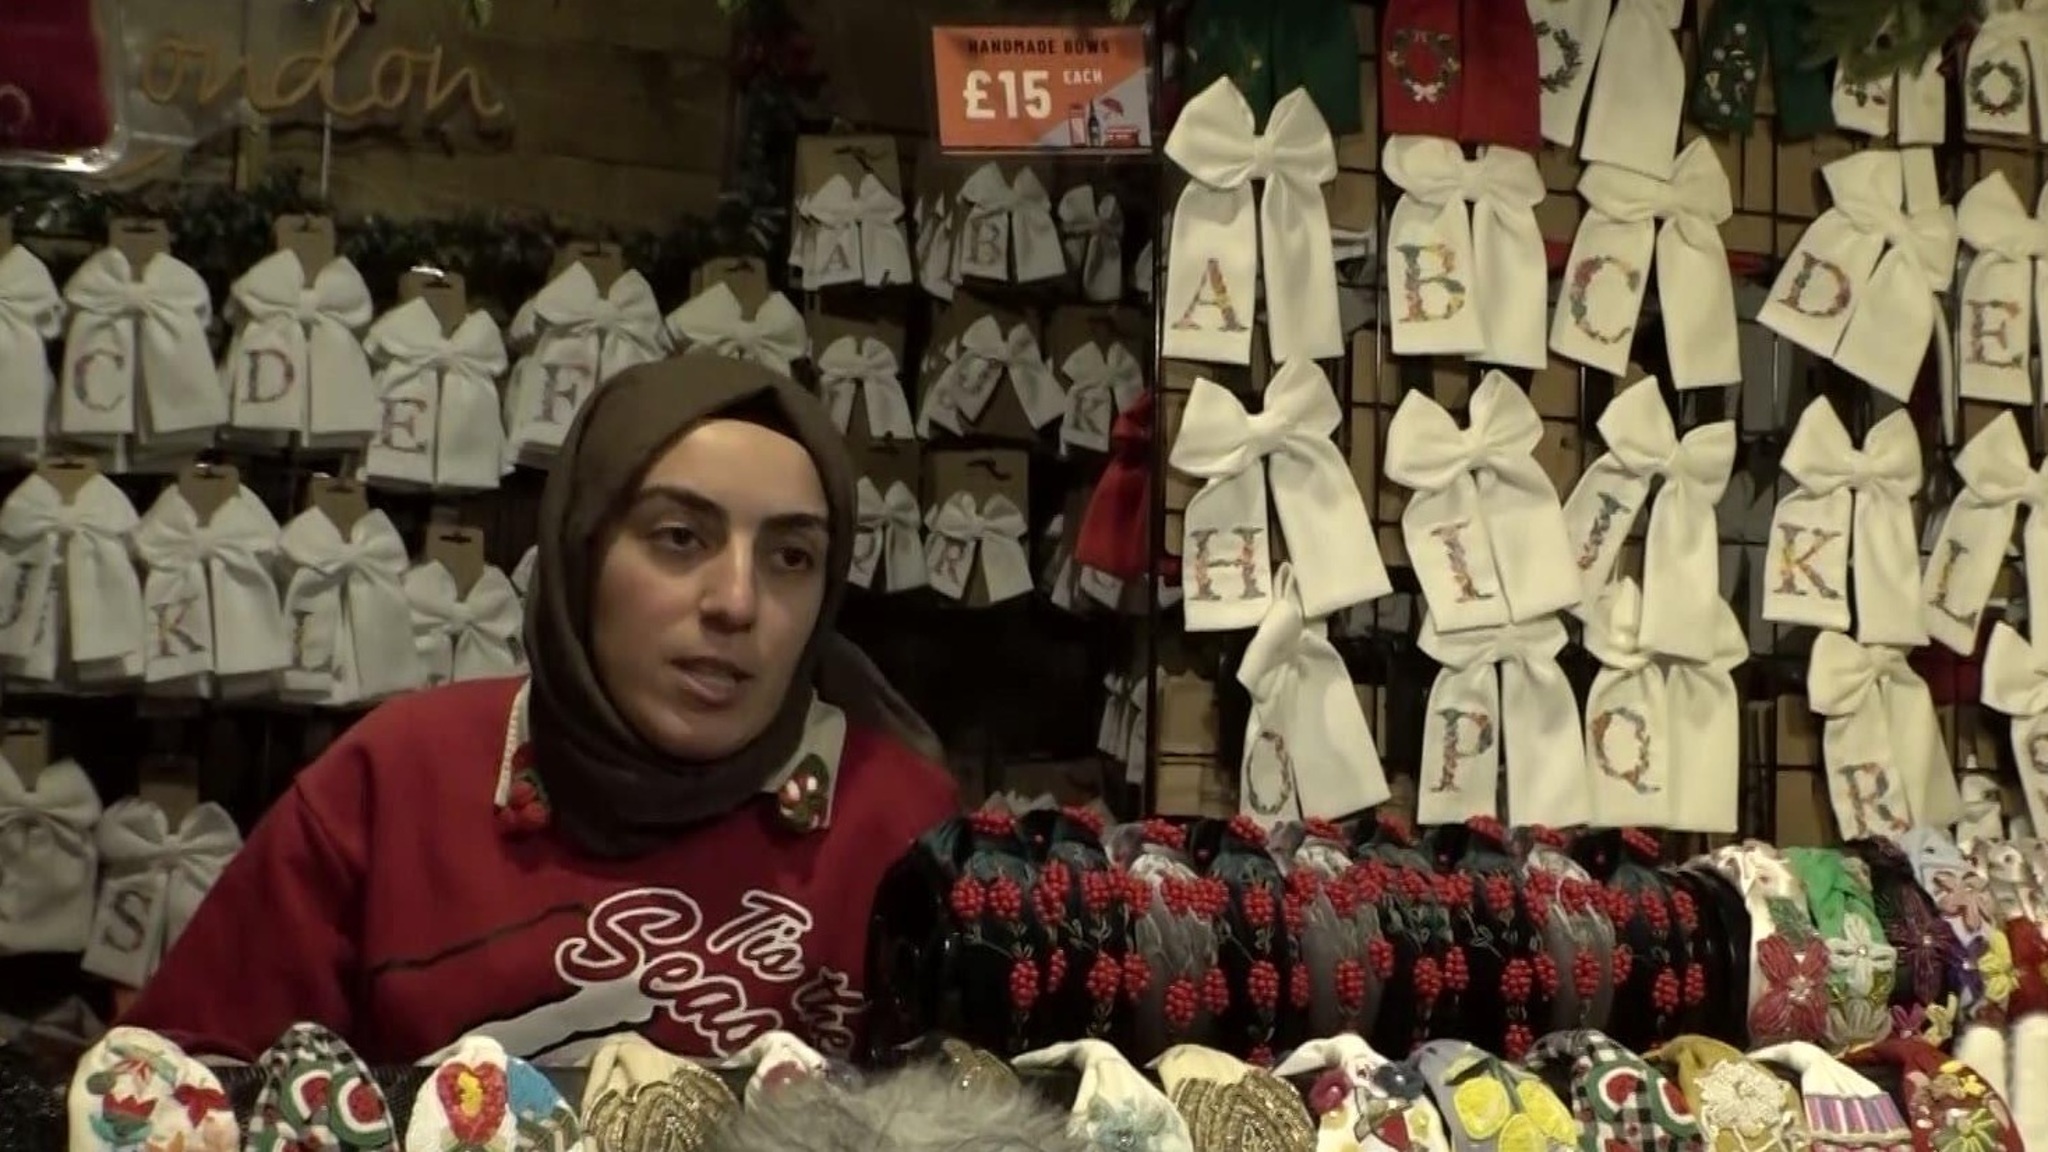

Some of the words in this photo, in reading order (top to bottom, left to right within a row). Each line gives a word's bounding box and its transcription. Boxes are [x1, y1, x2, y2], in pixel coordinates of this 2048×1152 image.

[140, 2, 506, 117] ondon
[967, 38, 1055, 56] HANDMADE
[1063, 38, 1111, 55] BOWS
[1062, 68, 1104, 86] EACH
[962, 68, 1052, 120] £15
[968, 219, 1000, 267] B
[1171, 257, 1248, 333] A
[1394, 242, 1466, 323] B
[1569, 253, 1641, 345] C
[1777, 250, 1852, 318] D
[1965, 299, 2023, 369] E
[73, 347, 125, 412] C
[243, 348, 296, 404] D
[533, 361, 592, 425] F
[378, 395, 429, 454] E
[1190, 525, 1267, 601] H
[1429, 520, 1495, 604] I
[1576, 491, 1632, 572] J
[1773, 522, 1843, 600] K
[1928, 538, 1979, 630] L
[149, 602, 207, 658] K
[1429, 706, 1494, 794] P
[1591, 705, 1662, 796] Q
[1837, 761, 1913, 840] R
[104, 890, 152, 953] S
